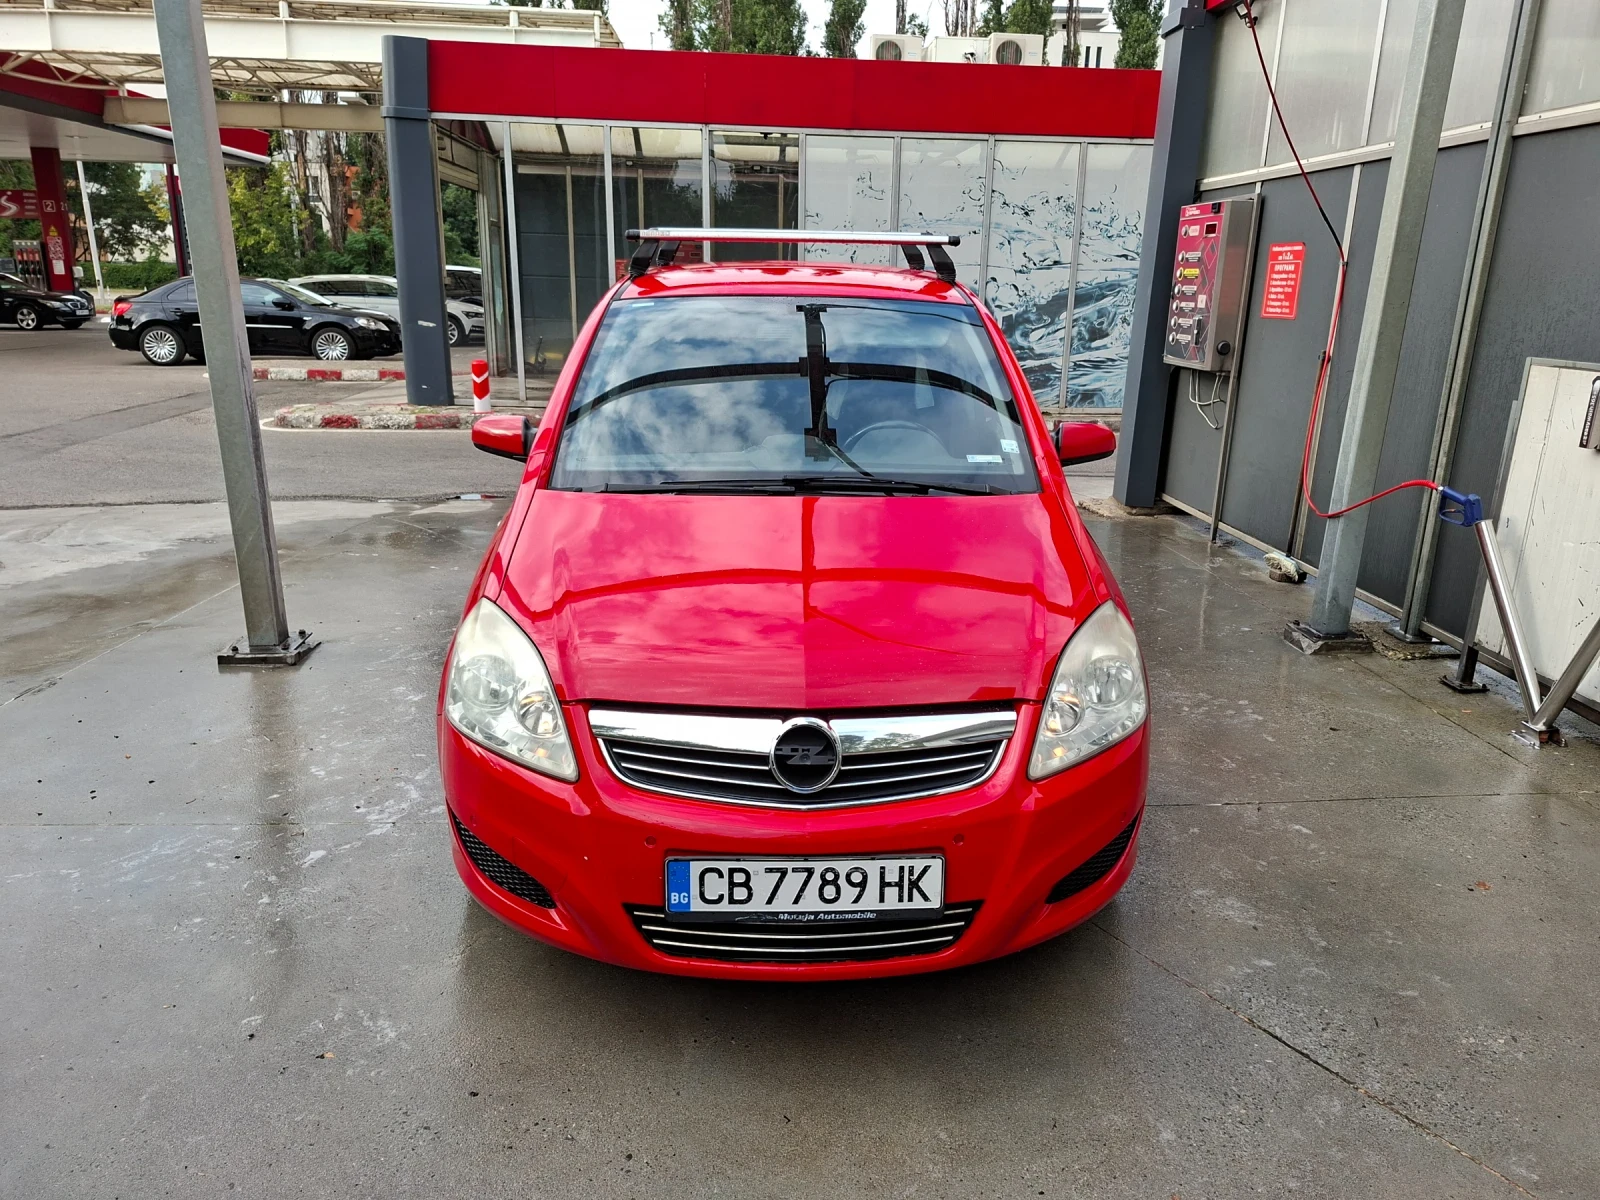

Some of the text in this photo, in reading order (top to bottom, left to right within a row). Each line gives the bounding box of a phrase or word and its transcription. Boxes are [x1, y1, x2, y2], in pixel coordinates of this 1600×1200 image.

[698, 864, 933, 906] CB 7789 HK
[670, 892, 689, 905] BG
[817, 911, 877, 920] Automobile
